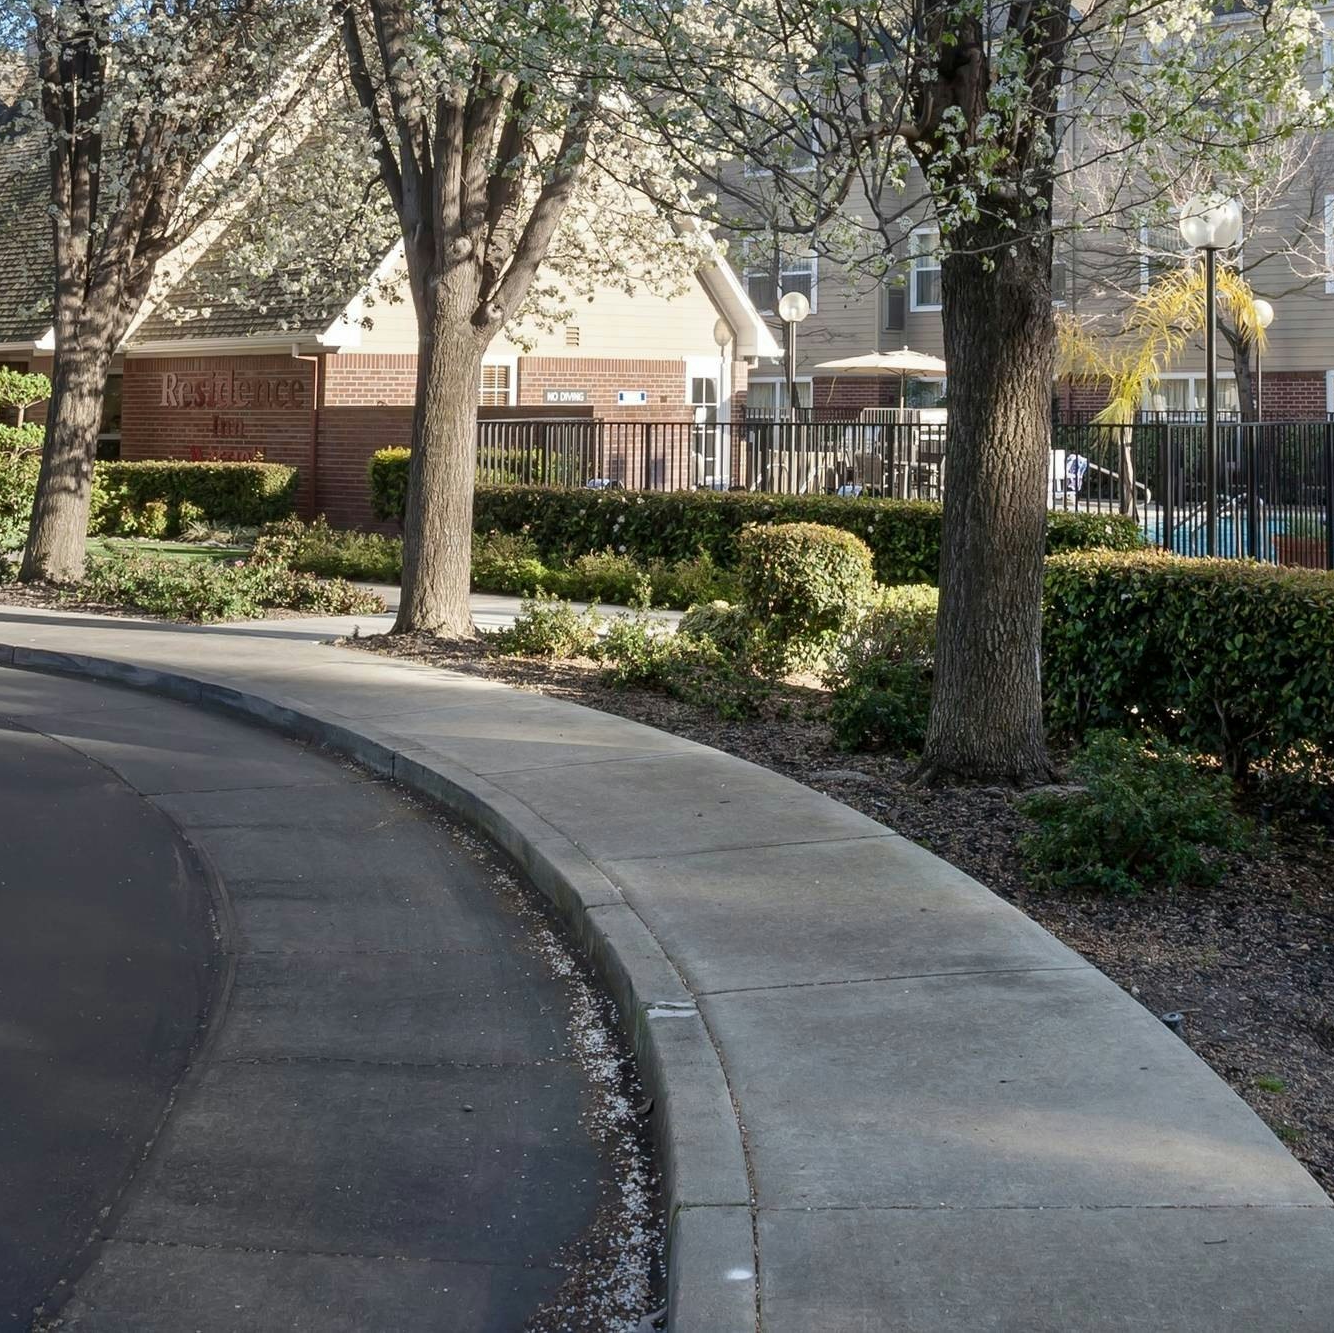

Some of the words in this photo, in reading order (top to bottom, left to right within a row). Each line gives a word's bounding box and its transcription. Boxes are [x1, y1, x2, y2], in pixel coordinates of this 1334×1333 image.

[159, 370, 305, 409] Residence
[547, 391, 559, 402] NO
[559, 391, 585, 402] DIVING
[212, 414, 245, 437] Inn
